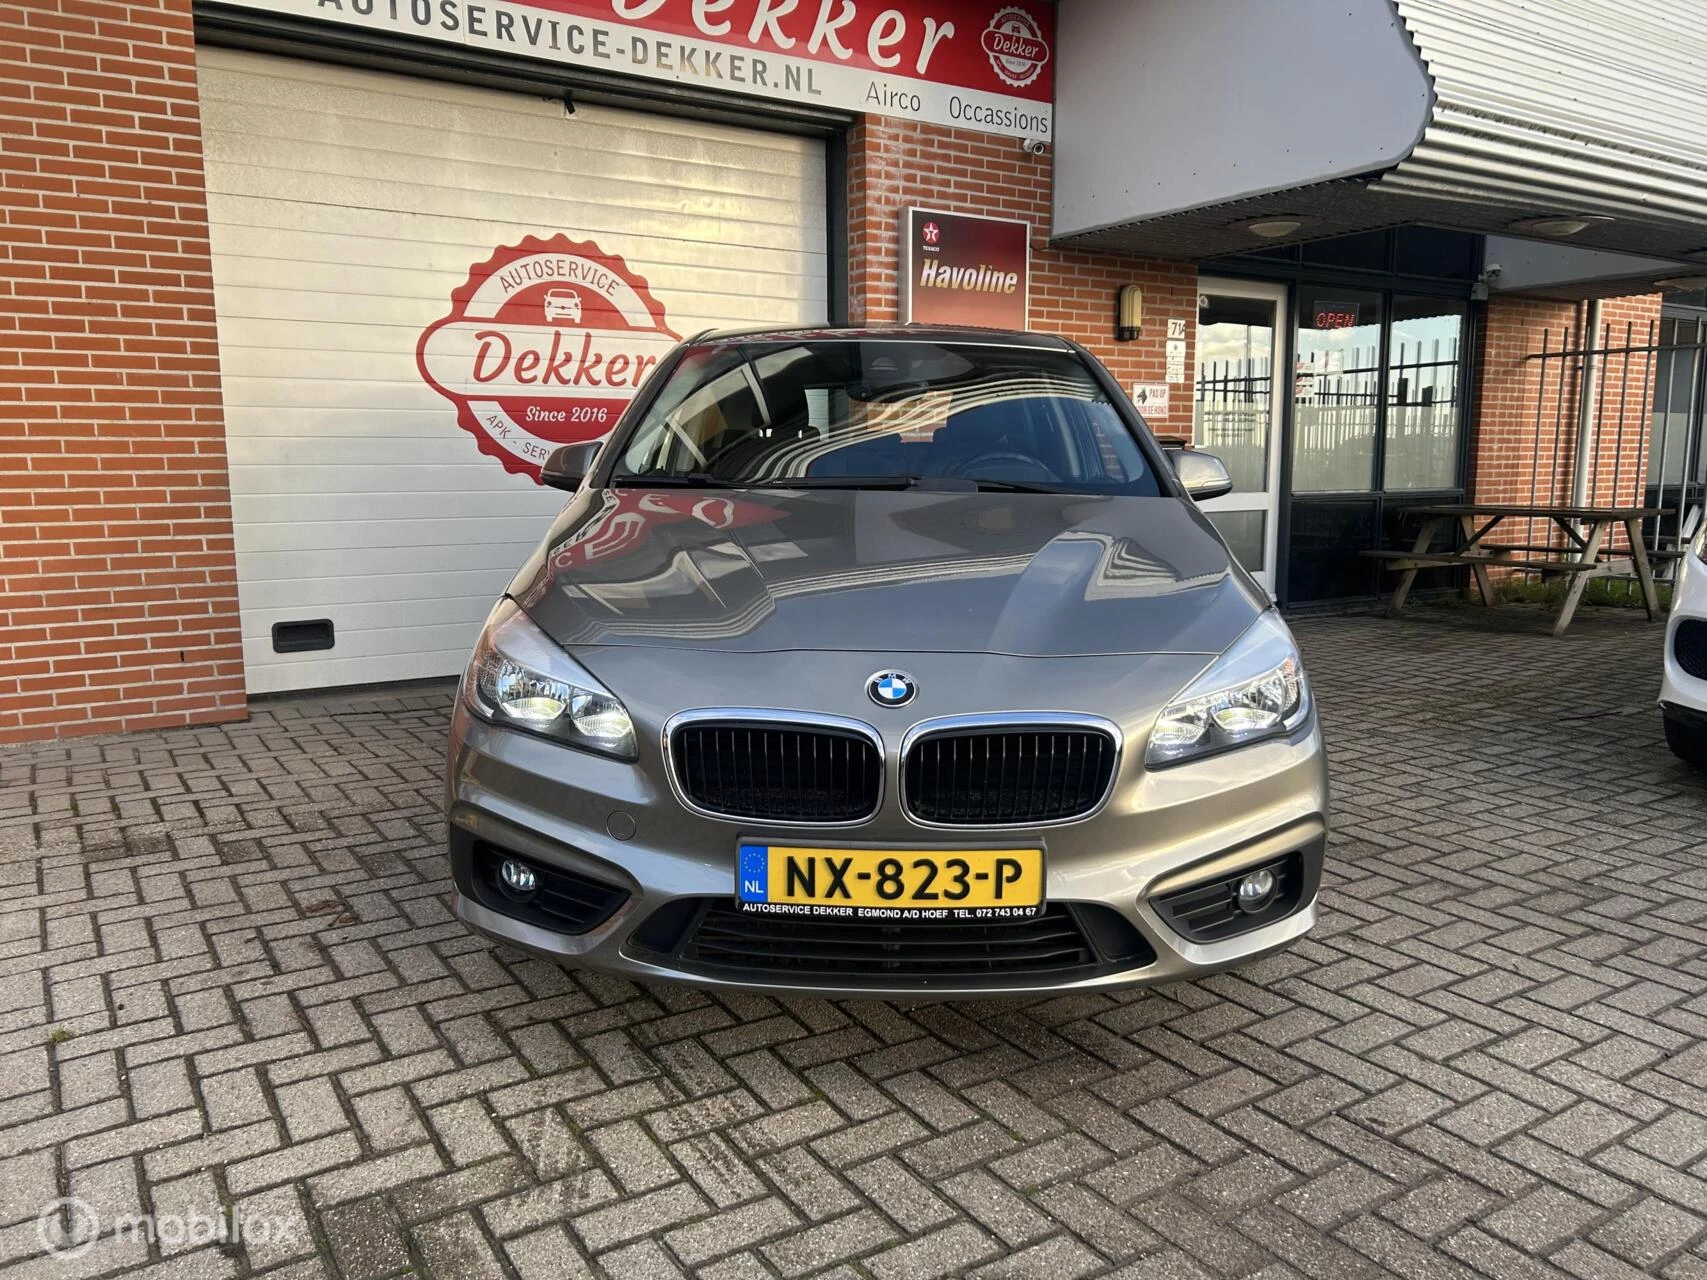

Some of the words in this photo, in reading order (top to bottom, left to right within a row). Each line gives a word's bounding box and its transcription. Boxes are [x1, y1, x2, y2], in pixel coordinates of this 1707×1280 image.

[611, 0, 956, 75] ekker
[993, 33, 1039, 58] Dekker
[865, 81, 921, 112] Airco
[949, 96, 1048, 134] Occassions
[921, 245, 941, 253] TEXACO
[499, 259, 621, 297] AUTOSERVICE
[919, 258, 1019, 295] Havoline
[1315, 312, 1356, 328] OPEN
[472, 329, 656, 388] Dekker
[525, 406, 566, 423] Since
[571, 406, 608, 423] 2016
[486, 415, 512, 440] APK
[744, 880, 764, 894] NL
[786, 854, 1023, 900] NX-823-P
[742, 903, 811, 915] AUTOSERVICE
[813, 905, 853, 916] DEKKER
[858, 908, 901, 918] EGMOND
[902, 909, 920, 918] A/D
[921, 909, 948, 918] HOEF
[953, 909, 974, 918] TEL.
[976, 909, 992, 918] 072
[994, 908, 1011, 917] 743
[1012, 907, 1024, 916] 04
[1025, 907, 1037, 916] 67
